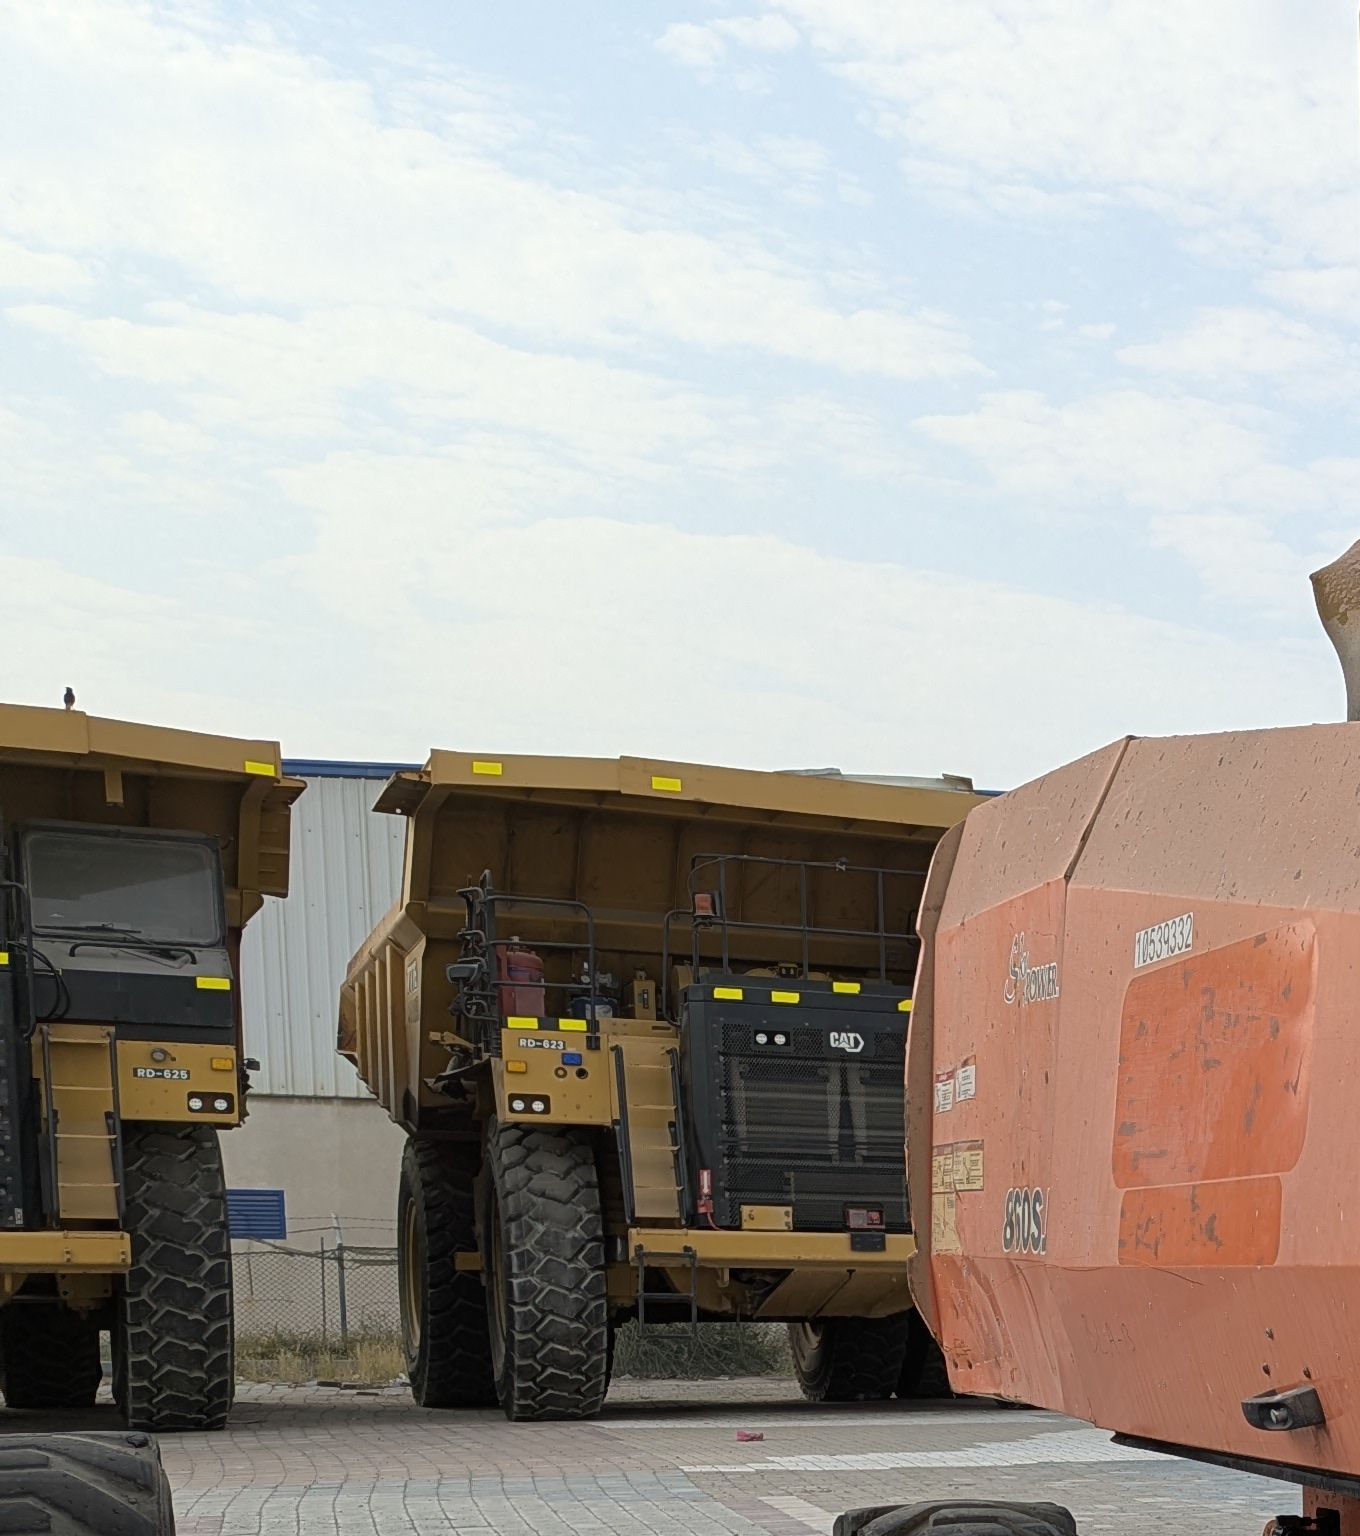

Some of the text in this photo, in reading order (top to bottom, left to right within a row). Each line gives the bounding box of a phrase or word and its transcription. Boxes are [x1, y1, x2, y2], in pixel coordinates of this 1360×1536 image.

[1136, 913, 1193, 966] 10539332
[519, 1038, 564, 1050] RD-623
[830, 1032, 859, 1050] CAT
[137, 1068, 188, 1080] RD-625
